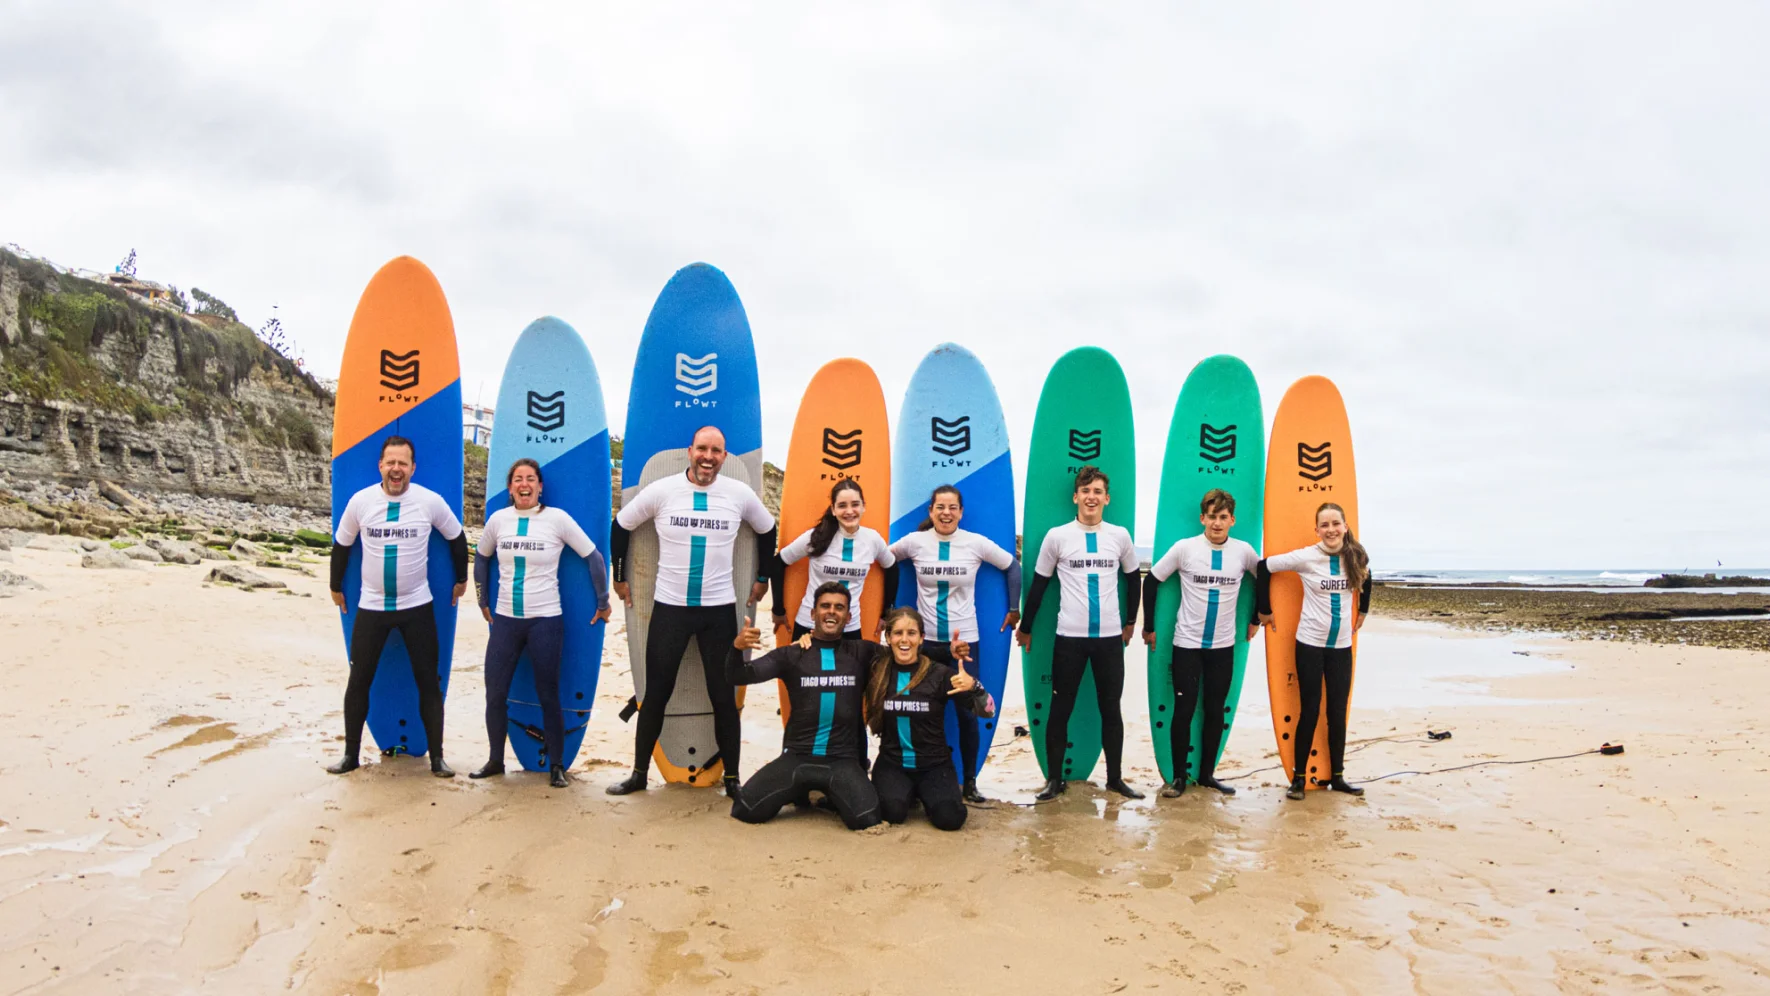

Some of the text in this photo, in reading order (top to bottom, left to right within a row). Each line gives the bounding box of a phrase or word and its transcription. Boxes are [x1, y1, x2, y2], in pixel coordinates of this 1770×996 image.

[379, 393, 419, 403] FLOWT
[675, 398, 717, 408] FLOWT
[526, 434, 565, 443] FLOWT
[932, 458, 971, 468] FLOWT
[1198, 465, 1235, 474] FLOWT
[1298, 483, 1333, 492] FLOWT
[669, 516, 689, 528] TIAGO
[699, 518, 720, 530] PIRES
[366, 527, 383, 538] TIAGO
[391, 528, 409, 538] PIRES
[520, 541, 537, 551] PIRES
[1069, 559, 1085, 569] TIAGO
[1092, 559, 1108, 568] PIRES
[823, 565, 839, 576] TIAGO
[845, 567, 861, 577] PIRES
[942, 566, 960, 576] PIRES
[1193, 575, 1208, 584] TIAGO
[800, 676, 819, 687] TIAGO
[828, 675, 848, 687] PIRES
[902, 700, 920, 712] PIRES
